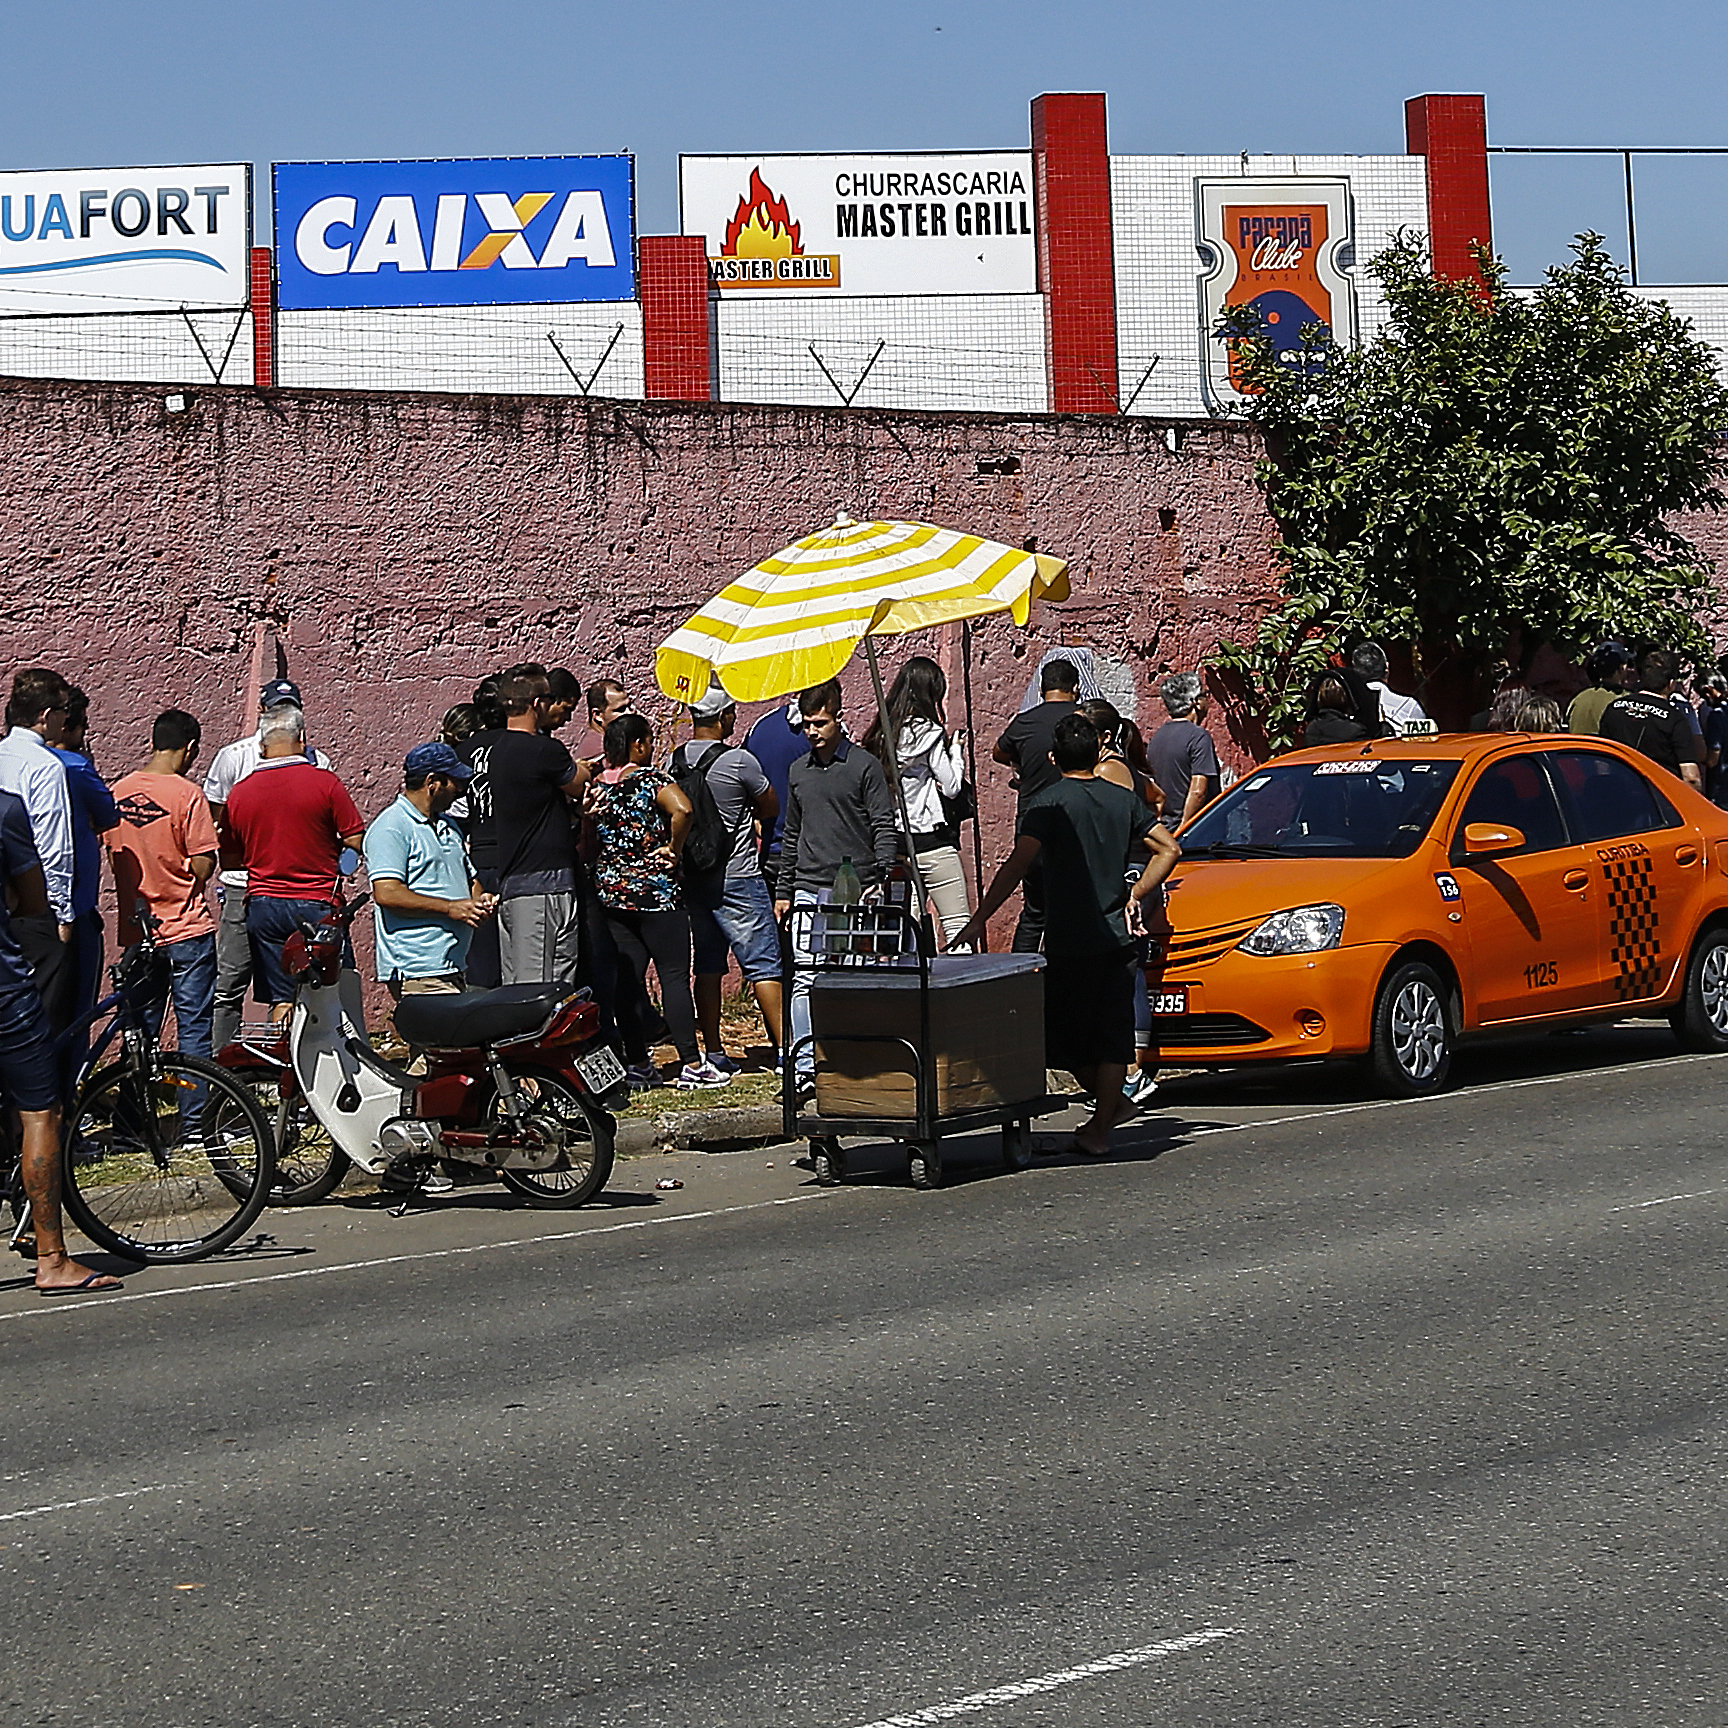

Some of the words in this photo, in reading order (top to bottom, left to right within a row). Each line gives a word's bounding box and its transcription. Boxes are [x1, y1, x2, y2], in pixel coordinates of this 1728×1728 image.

[835, 171, 1027, 197] CHURRASCARIA
[836, 202, 948, 238] MASTER
[955, 200, 1032, 237] GRILL
[295, 190, 617, 276] CAIXA
[1250, 235, 1304, 272] Clube
[778, 257, 833, 279] GRILL
[1405, 720, 1432, 733] TAXI
[1596, 842, 1651, 863] CURITIBA
[1441, 885, 1459, 897] 156
[1524, 960, 1559, 989] 1125
